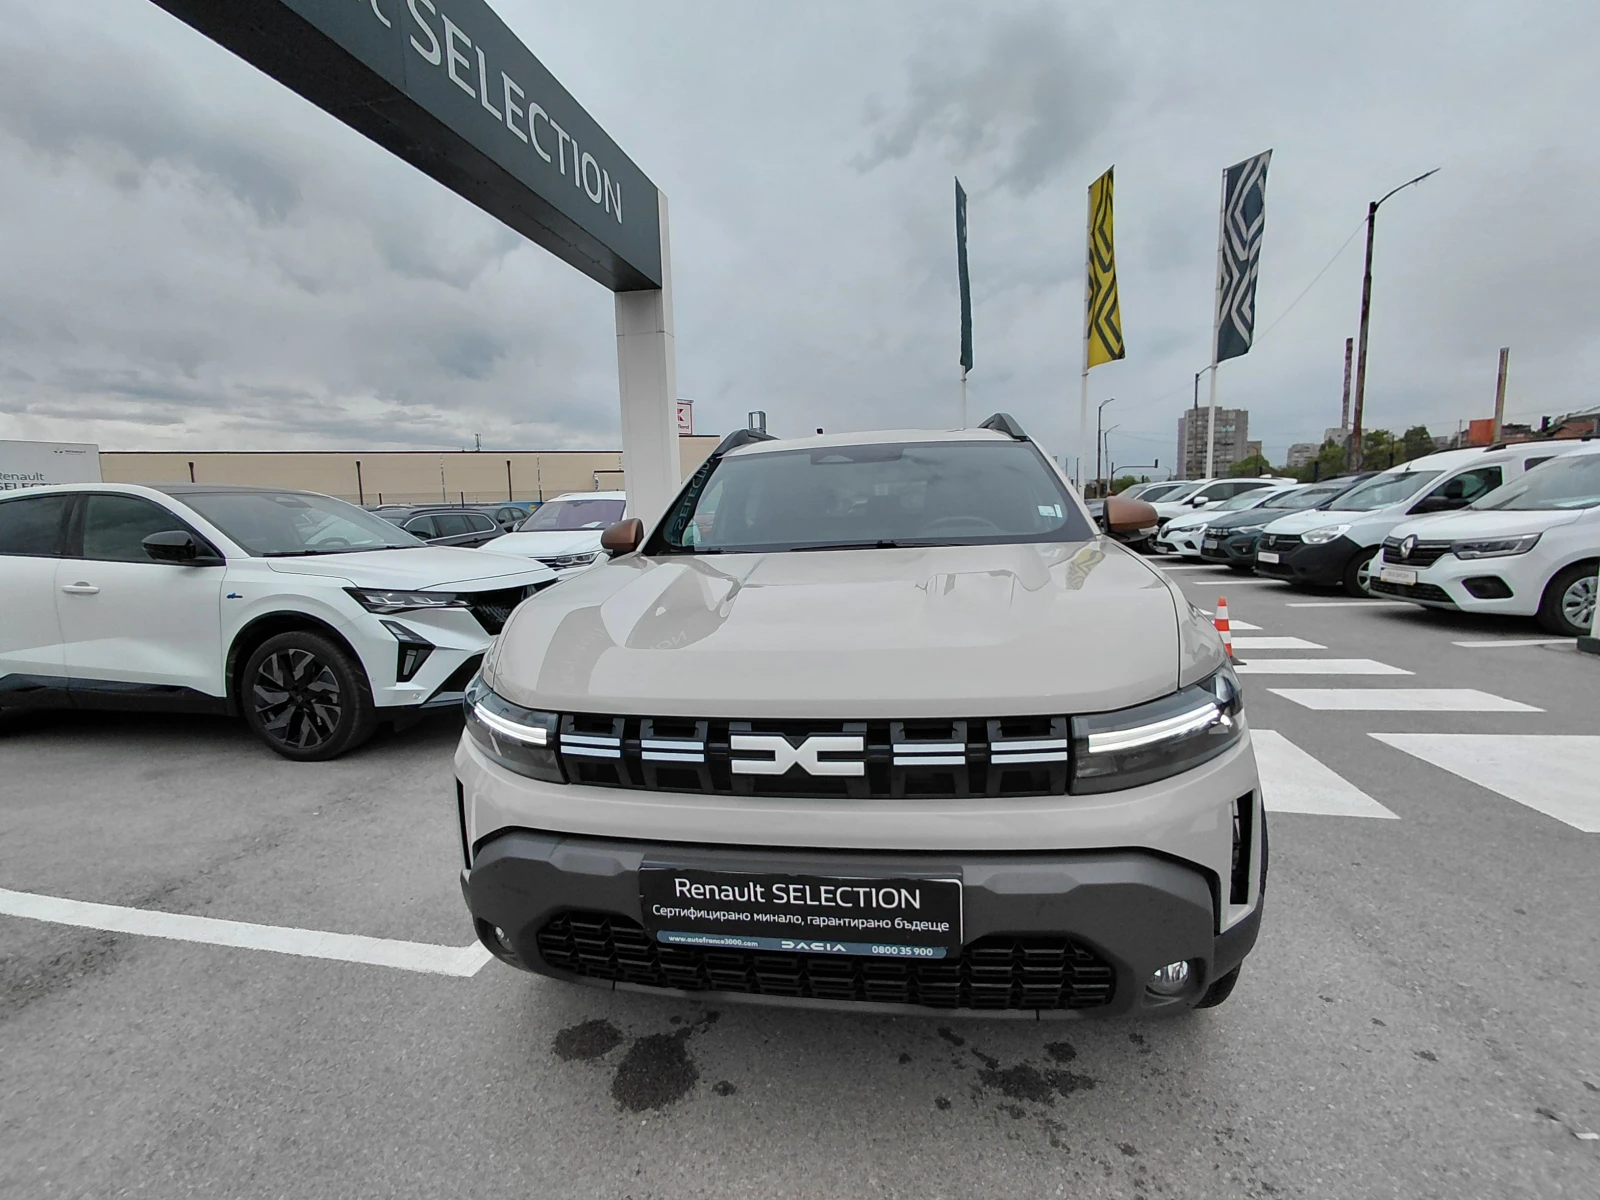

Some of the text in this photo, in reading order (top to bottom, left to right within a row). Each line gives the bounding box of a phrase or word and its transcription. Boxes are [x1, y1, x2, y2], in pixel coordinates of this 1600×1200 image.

[406, 0, 623, 224] SELECTION
[674, 878, 920, 909] Renault SELECTION
[652, 904, 950, 933] Сертифицирано минало, гарантирано бъдеще
[668, 935, 759, 947] www.autofrance3000.com
[781, 941, 847, 952] DACIA
[871, 945, 933, 957] 0800 35 900
